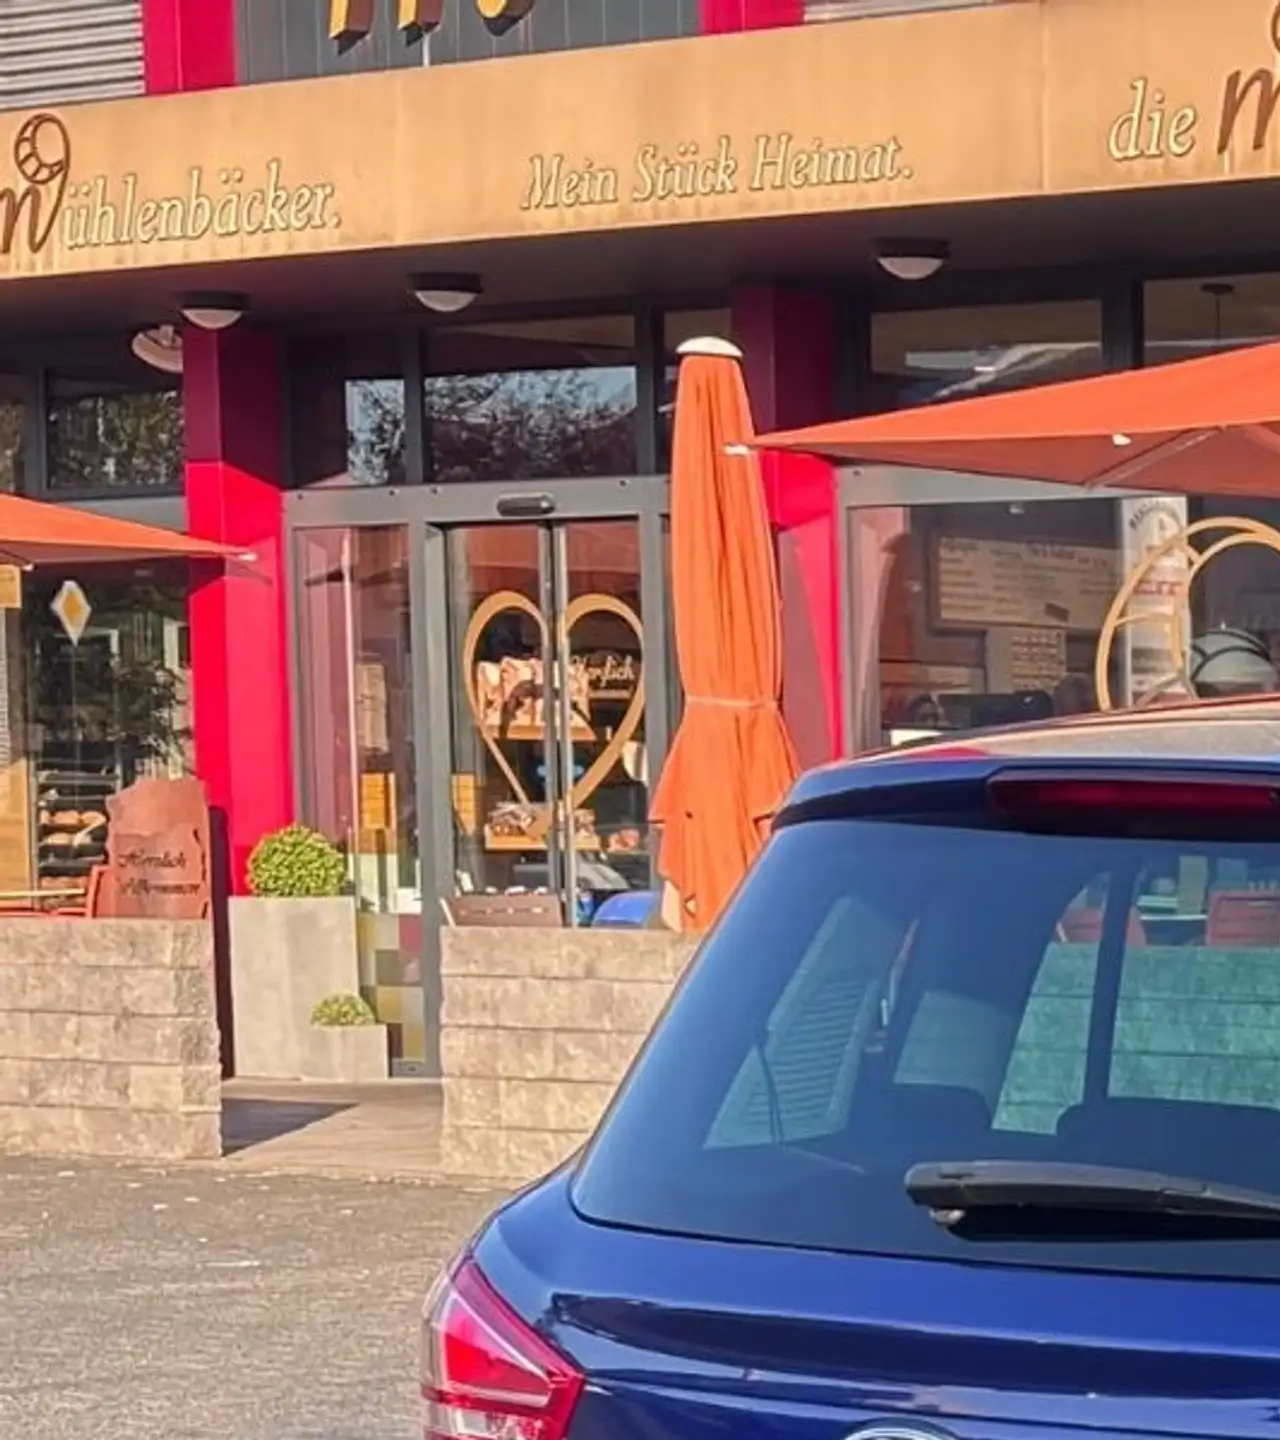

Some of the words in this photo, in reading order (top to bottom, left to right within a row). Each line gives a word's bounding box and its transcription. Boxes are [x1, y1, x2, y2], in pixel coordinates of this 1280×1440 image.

[1107, 75, 1197, 162] die
[520, 154, 619, 210] Mein
[633, 134, 738, 202] Stück
[749, 132, 913, 193] Heimat.
